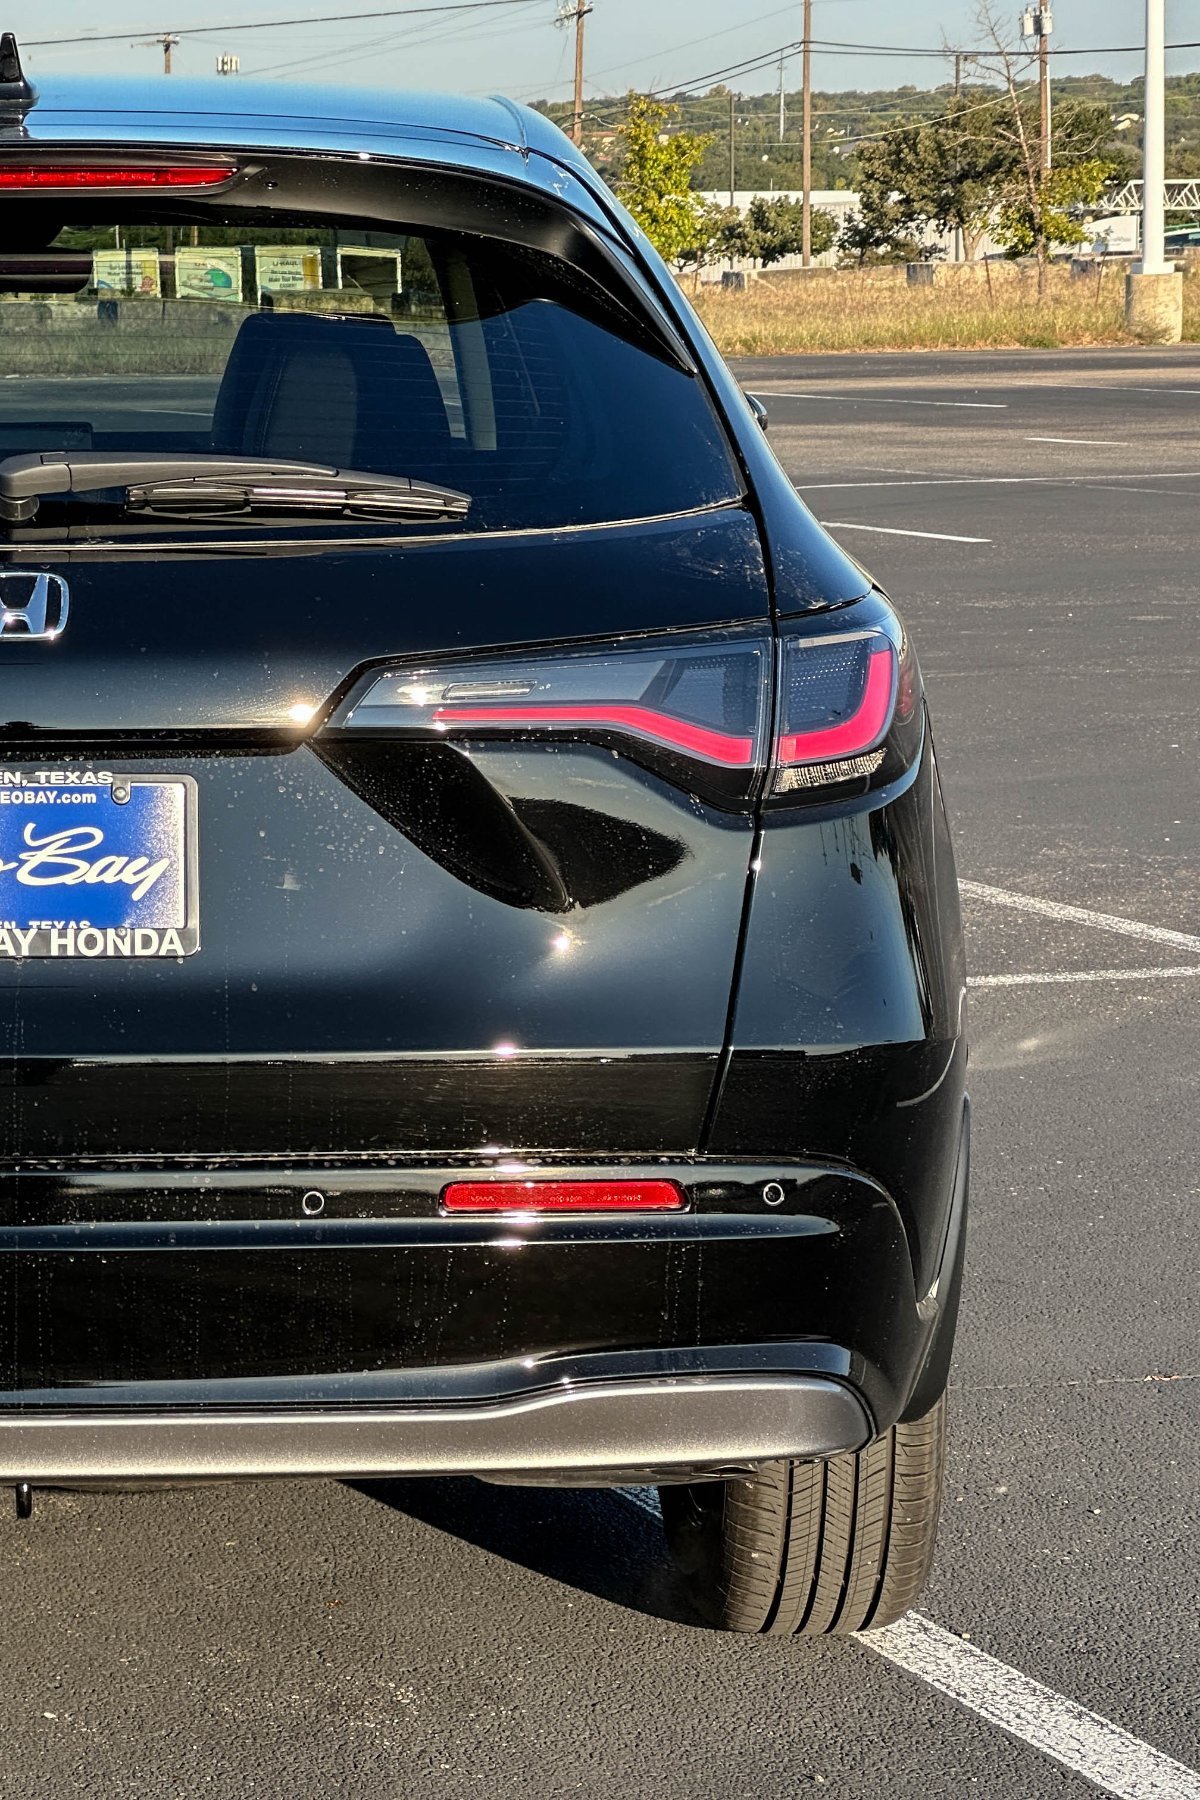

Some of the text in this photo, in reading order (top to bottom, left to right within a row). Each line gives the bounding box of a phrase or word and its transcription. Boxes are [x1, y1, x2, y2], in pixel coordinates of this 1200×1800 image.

[35, 771, 114, 784] TEXAS
[16, 822, 169, 901] Bay
[50, 928, 185, 958] HONDA
